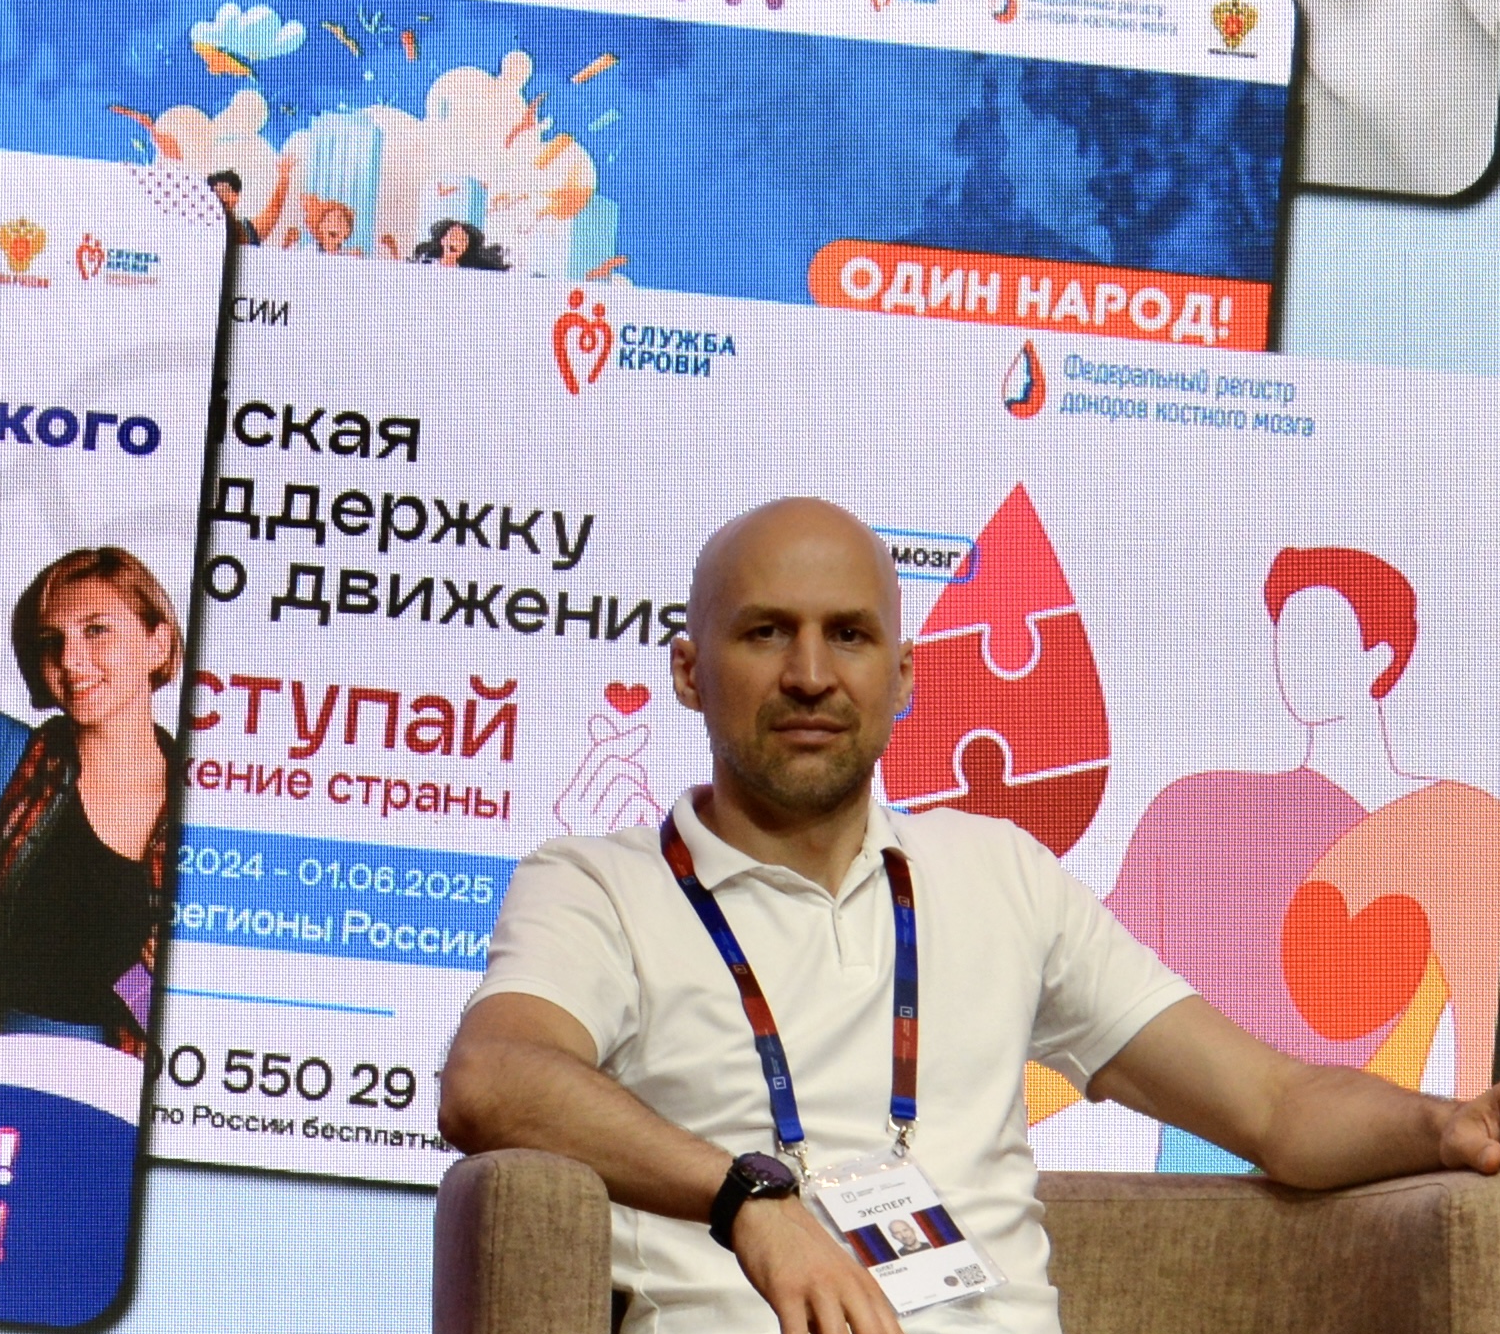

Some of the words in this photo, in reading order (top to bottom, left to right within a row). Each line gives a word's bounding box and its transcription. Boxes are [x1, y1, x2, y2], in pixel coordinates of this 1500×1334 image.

[839, 254, 1002, 315] ОДИН
[1016, 275, 1233, 345] НАРОД!
[618, 347, 713, 378] КРОВИ
[619, 323, 738, 358] СЛУЖБА
[1061, 351, 1211, 395] Федеральный
[1215, 373, 1297, 408] регистр
[1059, 390, 1148, 423] доноров
[1154, 397, 1248, 430] костного
[1252, 408, 1316, 439] мозга
[328, 770, 512, 821] страны
[298, 858, 495, 904] 01.06.2025
[341, 910, 491, 958] России
[222, 1048, 334, 1102] 550
[349, 1062, 417, 1110] 29
[192, 1104, 295, 1137] России
[857, 1196, 913, 1218] ЭКСПЕРТ
